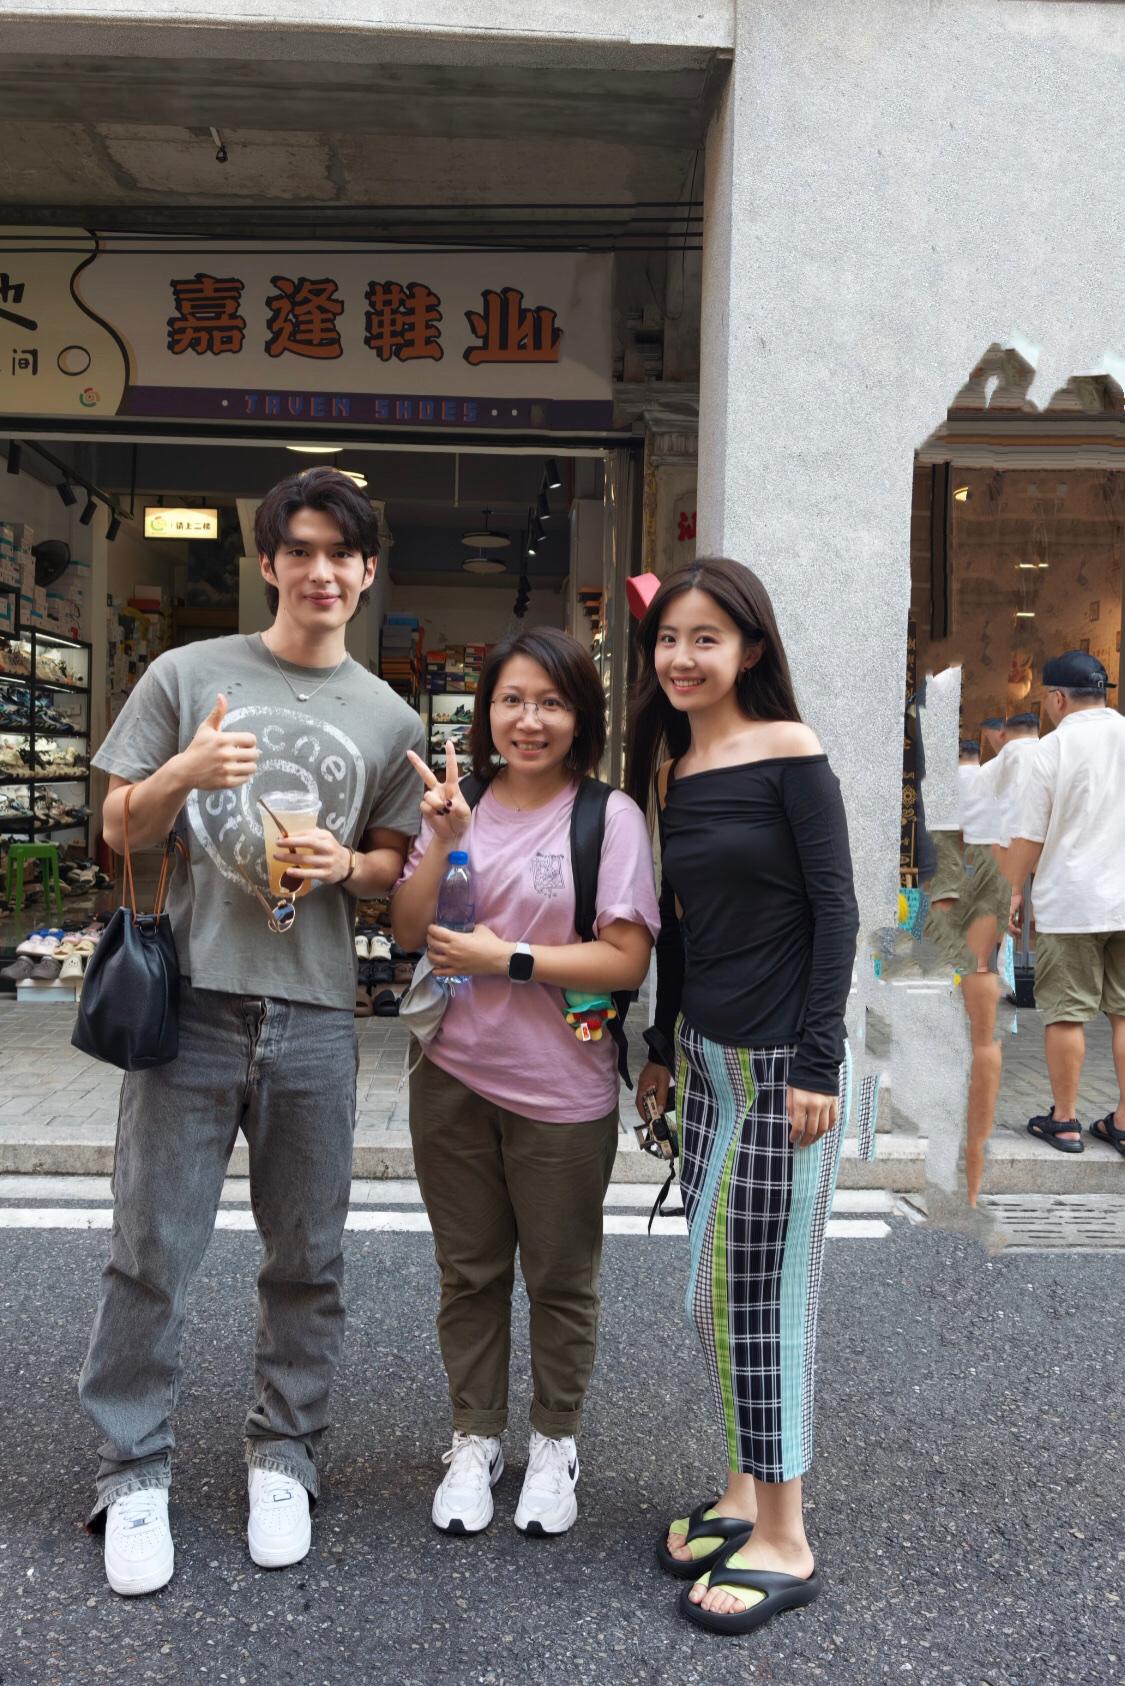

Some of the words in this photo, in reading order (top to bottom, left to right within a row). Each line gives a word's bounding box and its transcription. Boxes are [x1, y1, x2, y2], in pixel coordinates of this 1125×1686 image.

[167, 273, 563, 366] 嘉逢鞋业
[374, 399, 479, 422] SHOES
